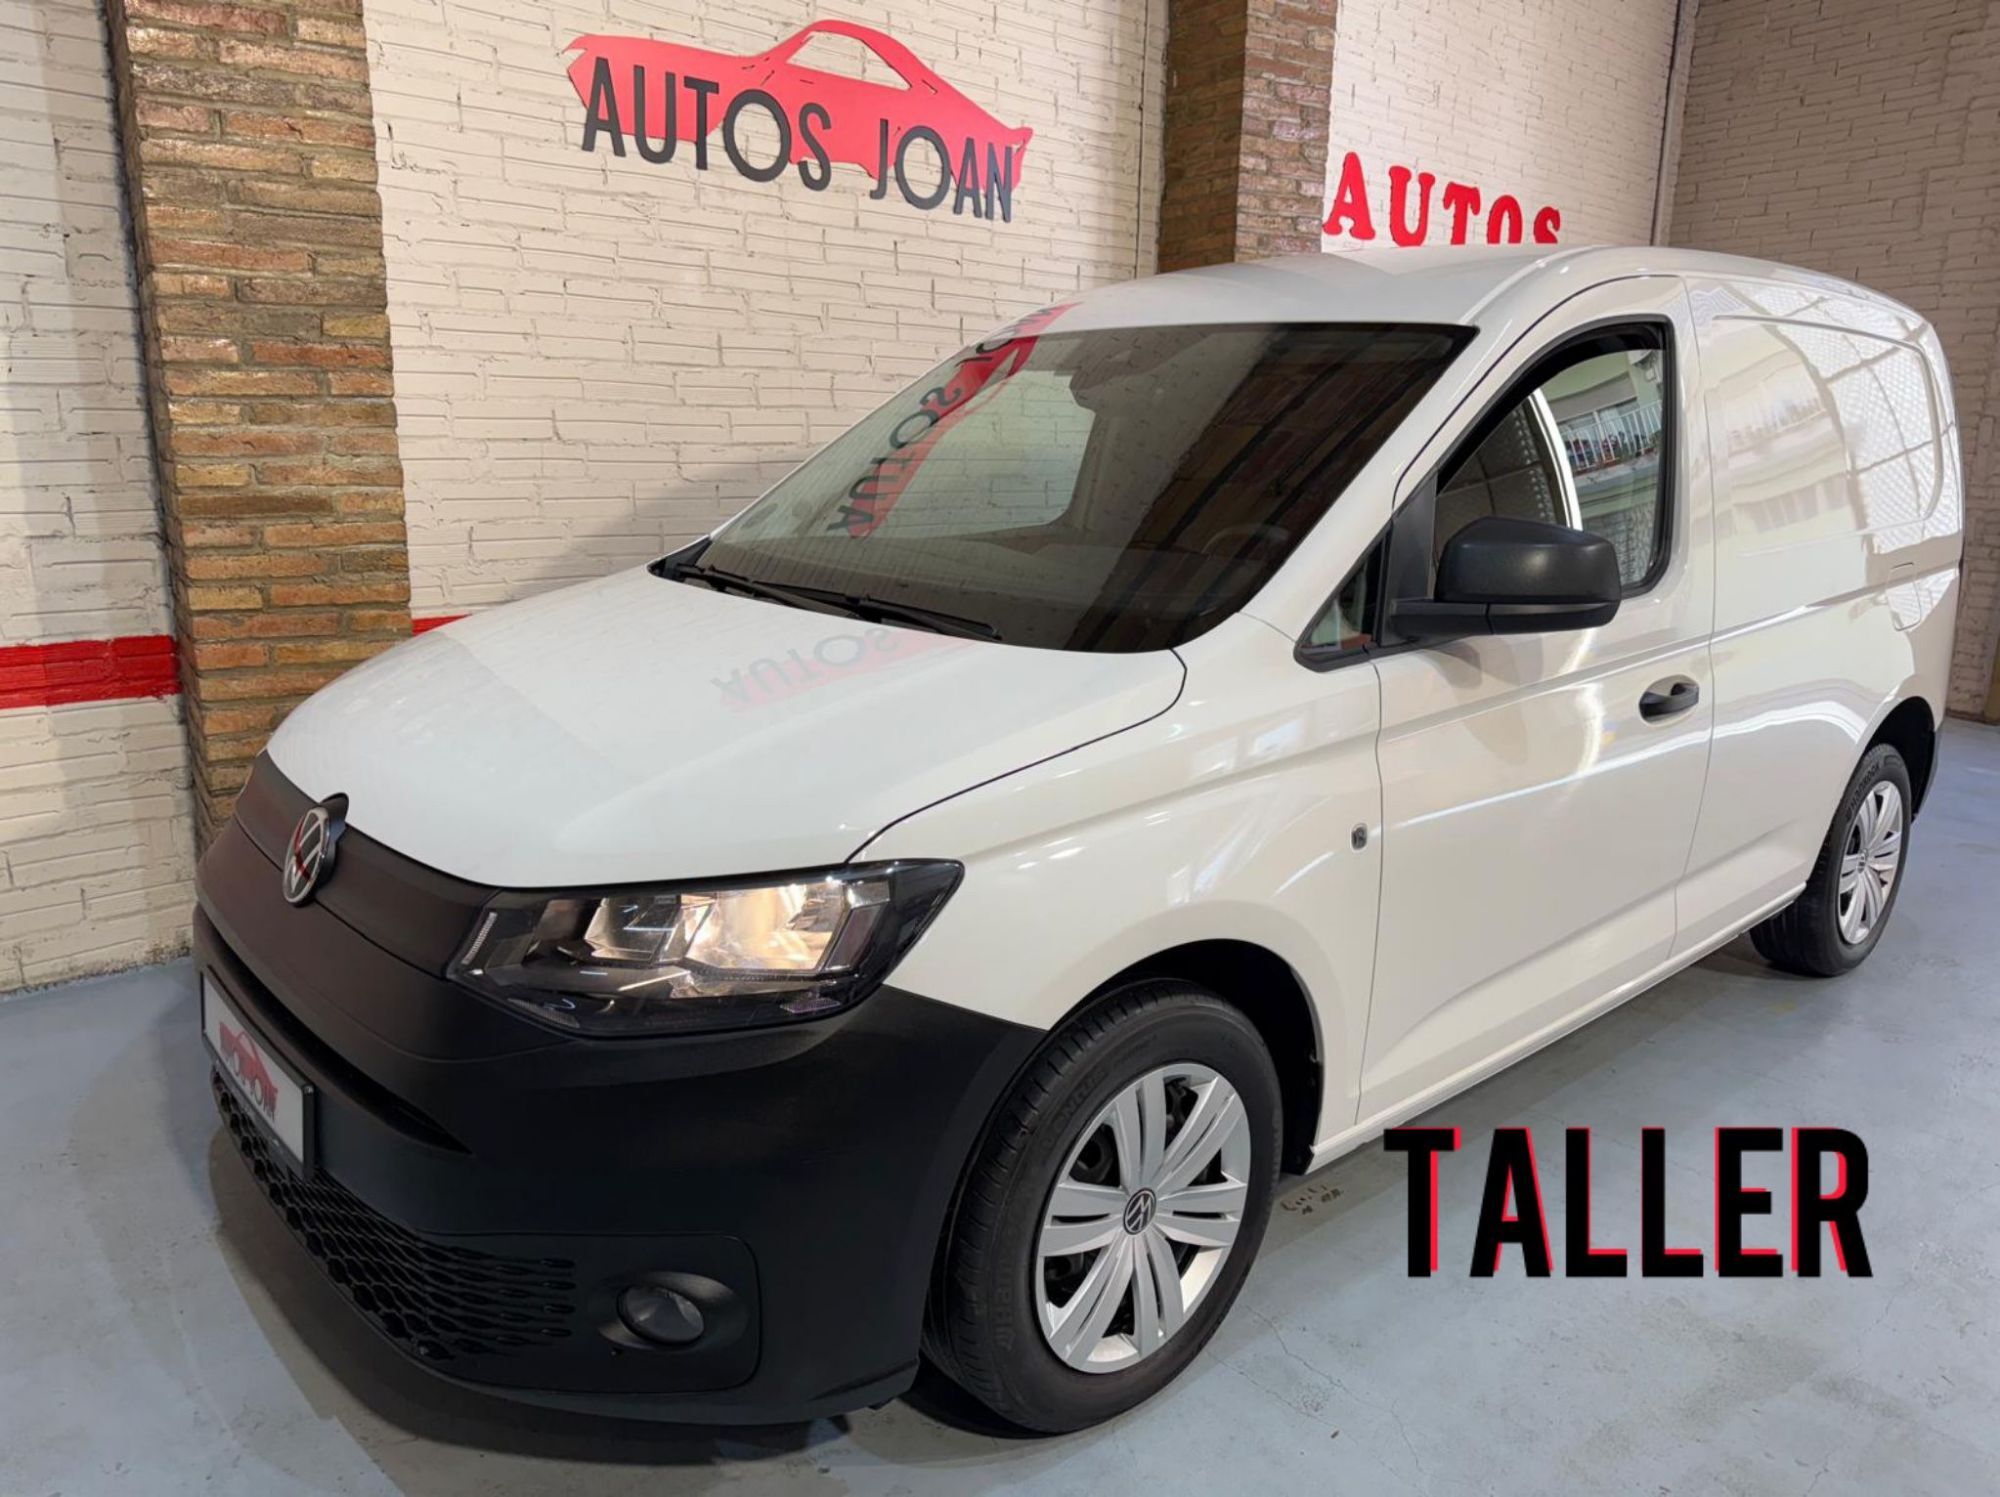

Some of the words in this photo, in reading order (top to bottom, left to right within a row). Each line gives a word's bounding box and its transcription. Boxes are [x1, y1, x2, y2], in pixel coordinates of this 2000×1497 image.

[581, 56, 833, 192] AUTOS
[870, 118, 1013, 224] JOAN
[1322, 151, 1561, 248] AUTOS
